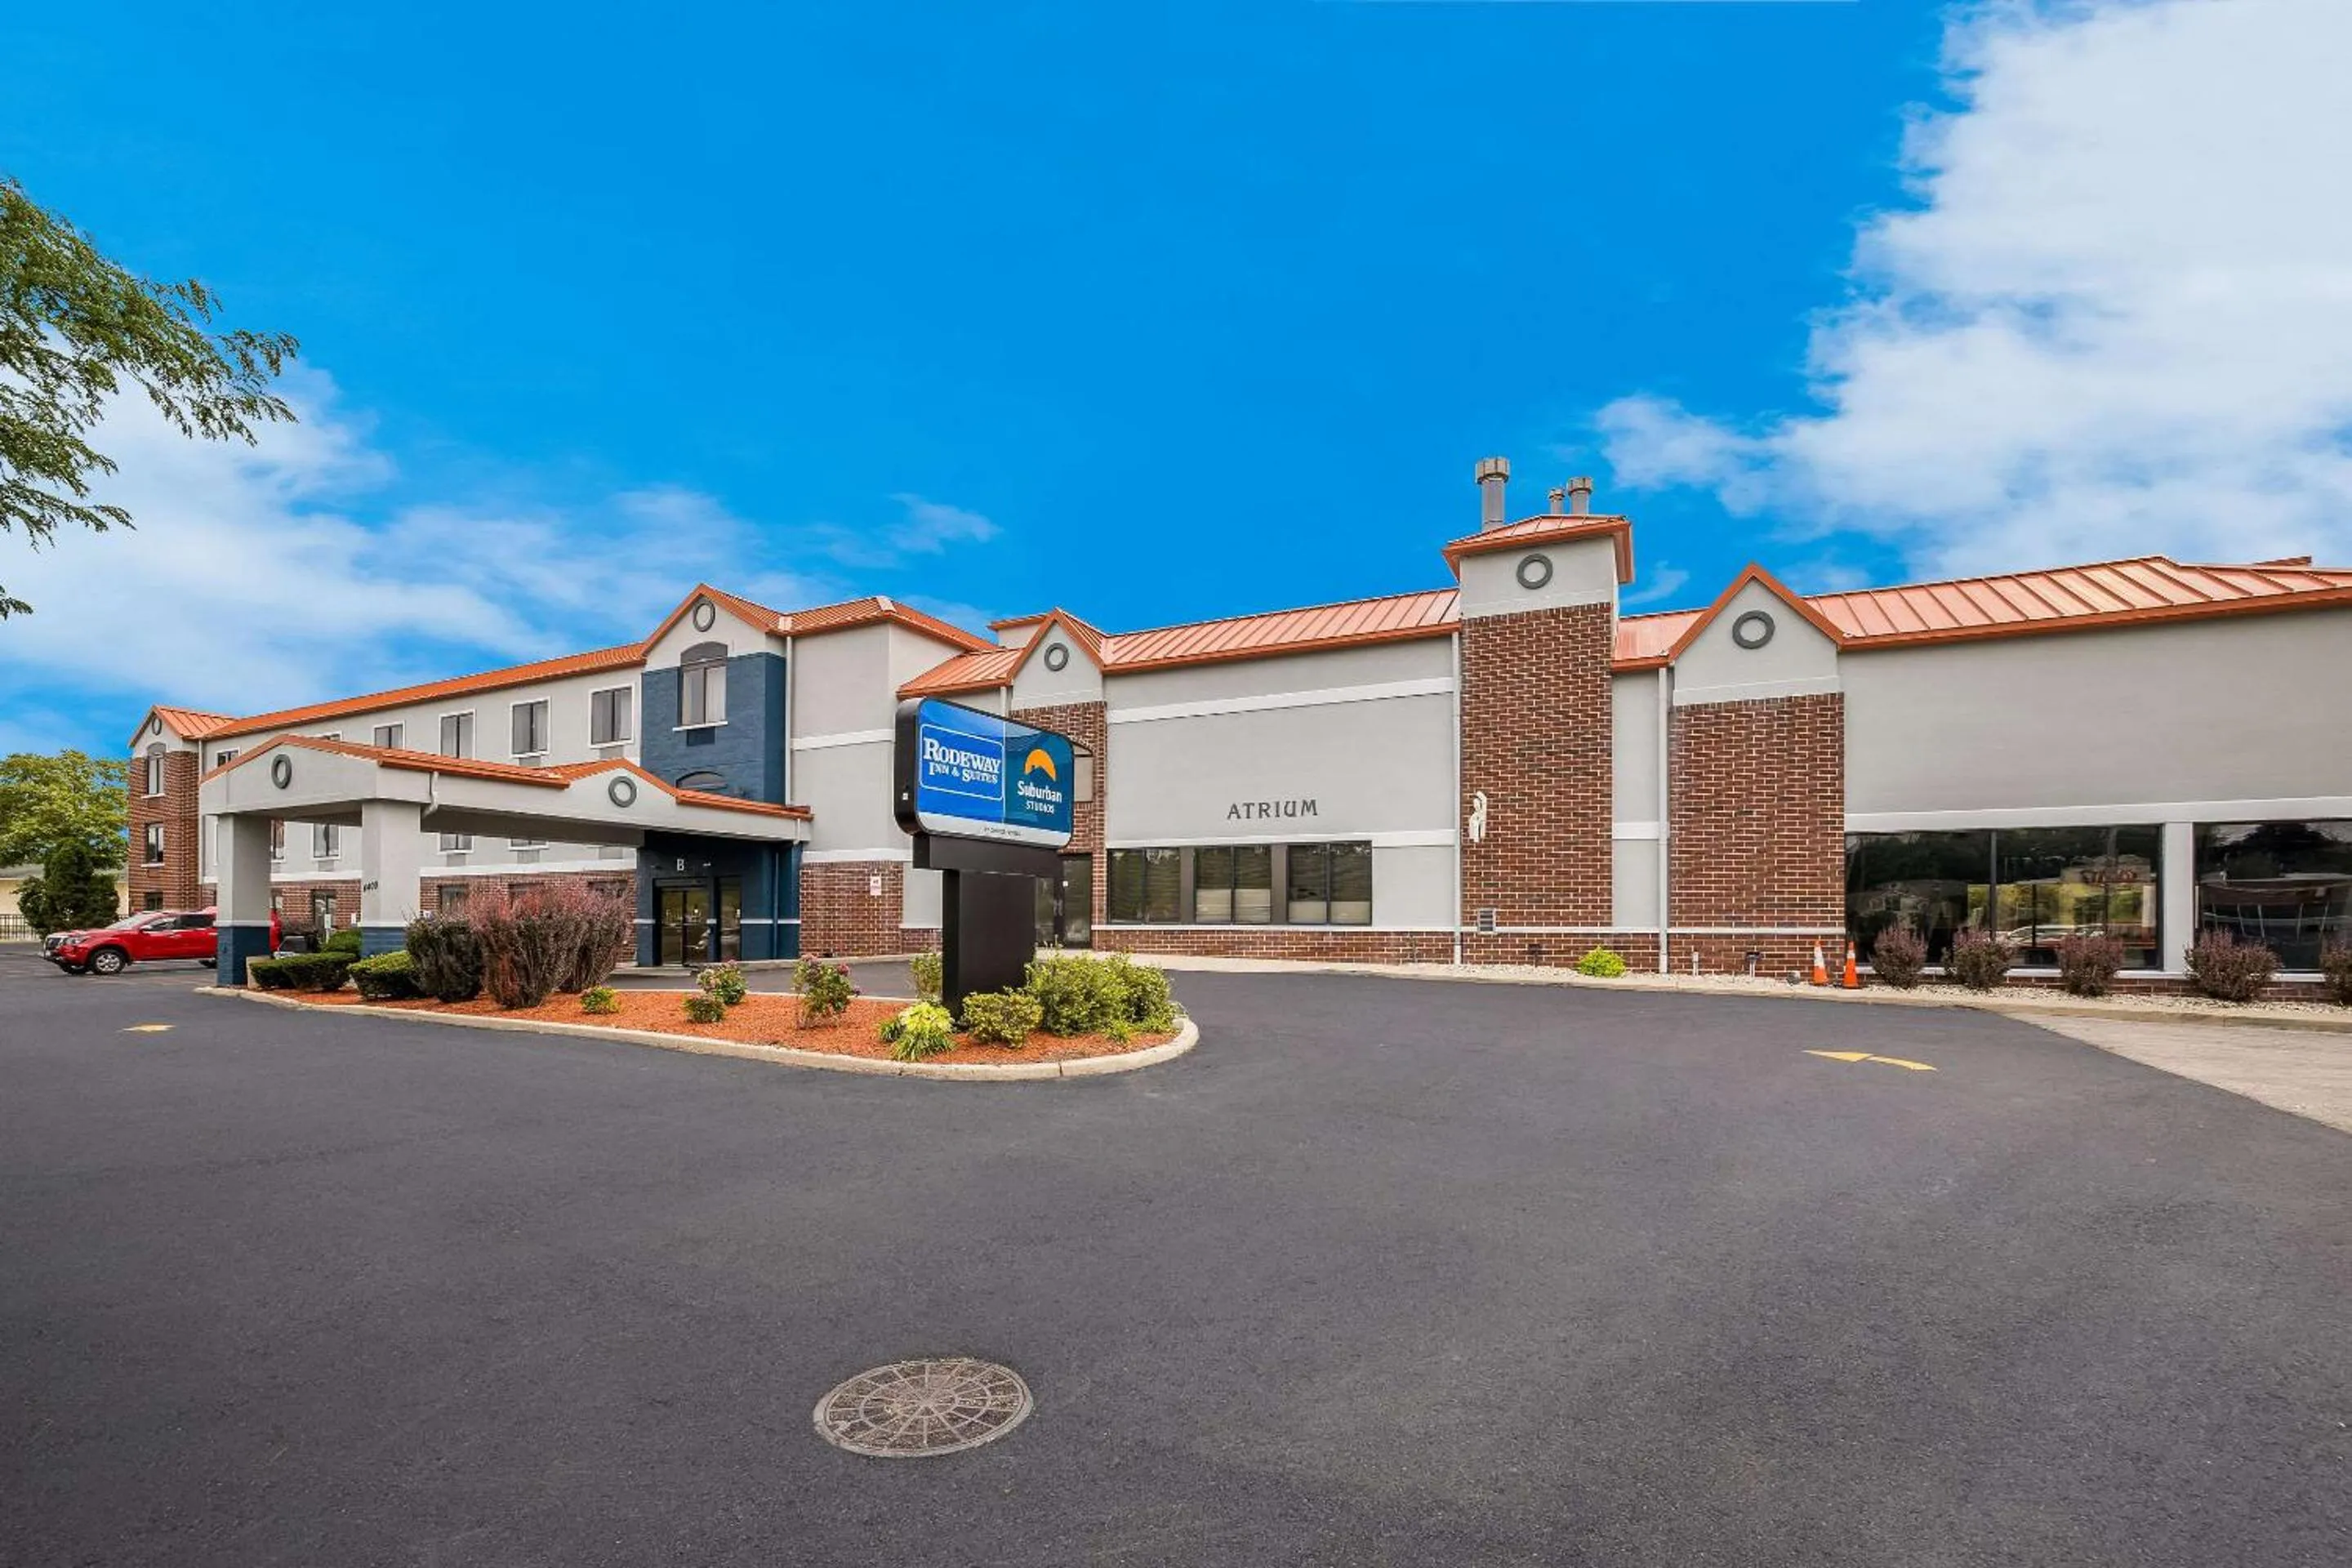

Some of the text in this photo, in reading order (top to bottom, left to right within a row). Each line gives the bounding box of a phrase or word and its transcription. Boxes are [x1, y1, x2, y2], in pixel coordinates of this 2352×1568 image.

[929, 762, 998, 784] INN & SUITES
[1018, 781, 1062, 803] Suburban
[1227, 800, 1318, 820] ATRIUM
[677, 858, 684, 871] B
